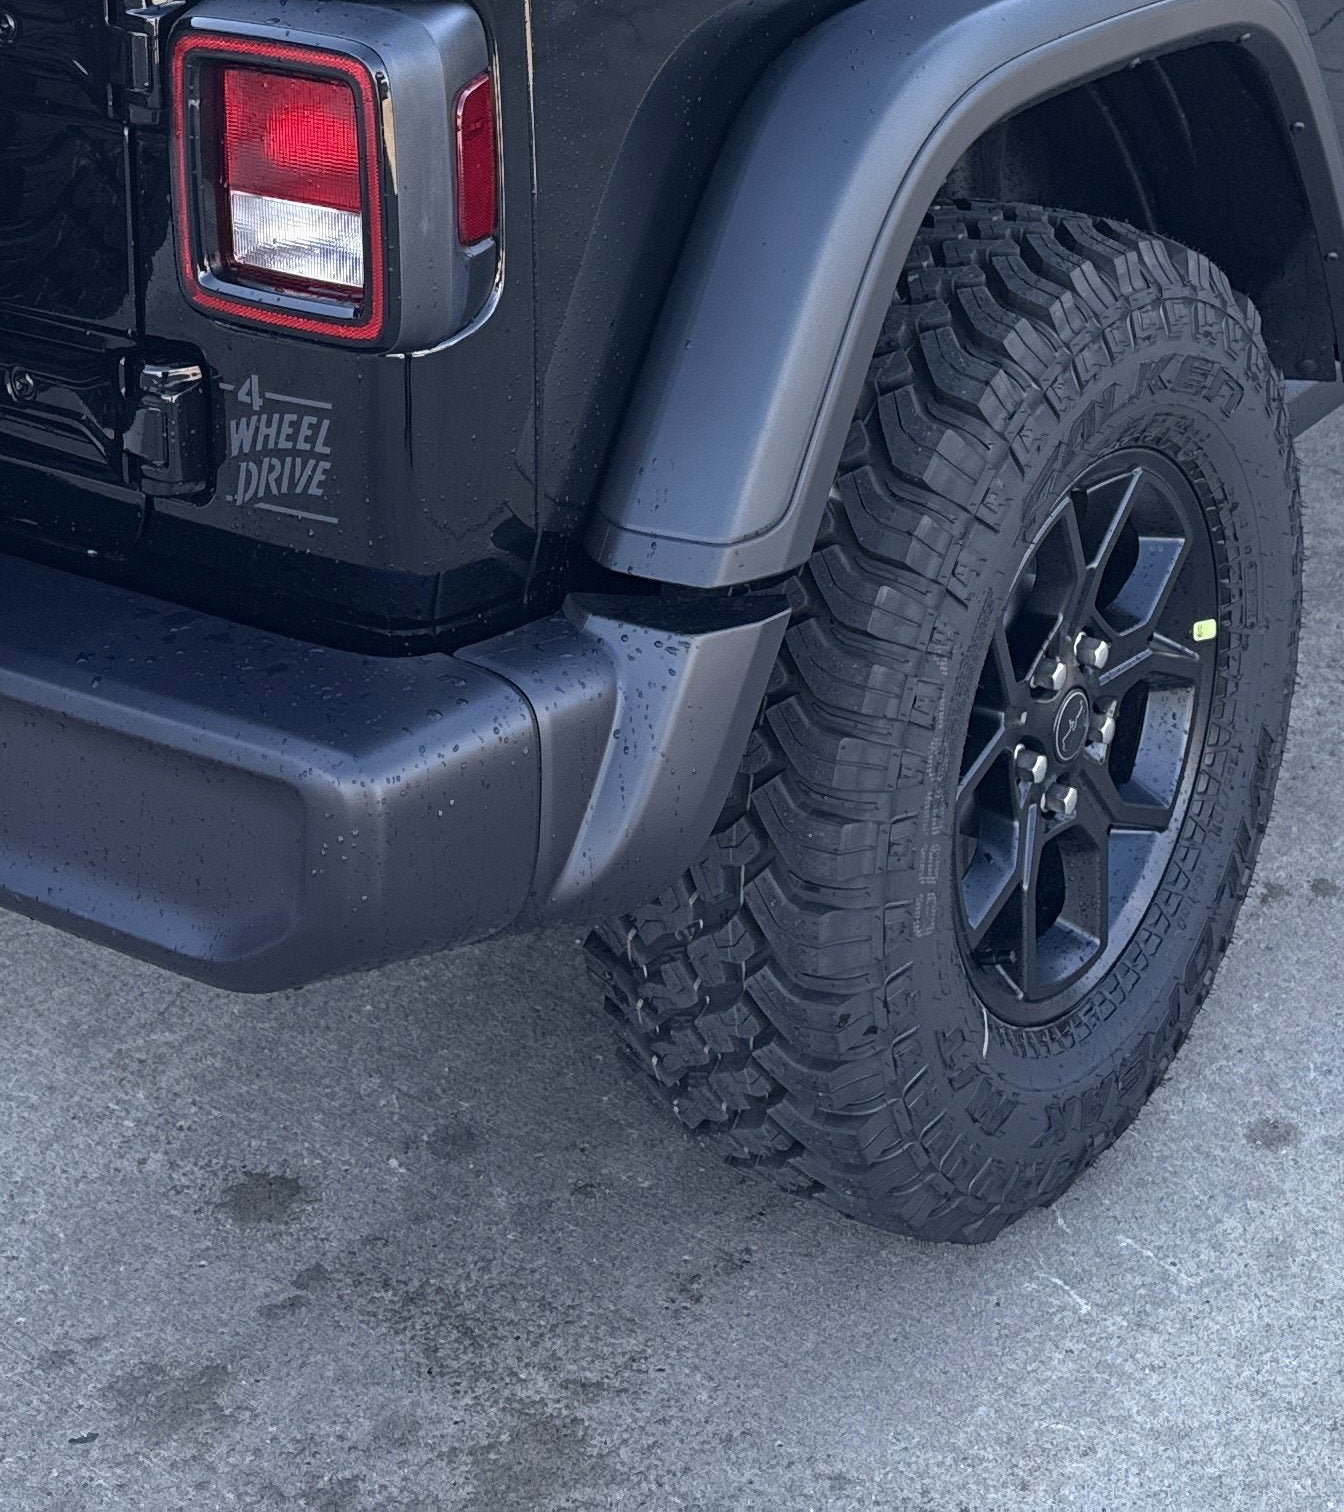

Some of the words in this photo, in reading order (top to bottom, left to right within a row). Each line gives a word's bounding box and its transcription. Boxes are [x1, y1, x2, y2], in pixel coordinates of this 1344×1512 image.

[237, 374, 263, 411] 4
[229, 412, 332, 457] WHEEL
[236, 454, 332, 507] DRIVE
